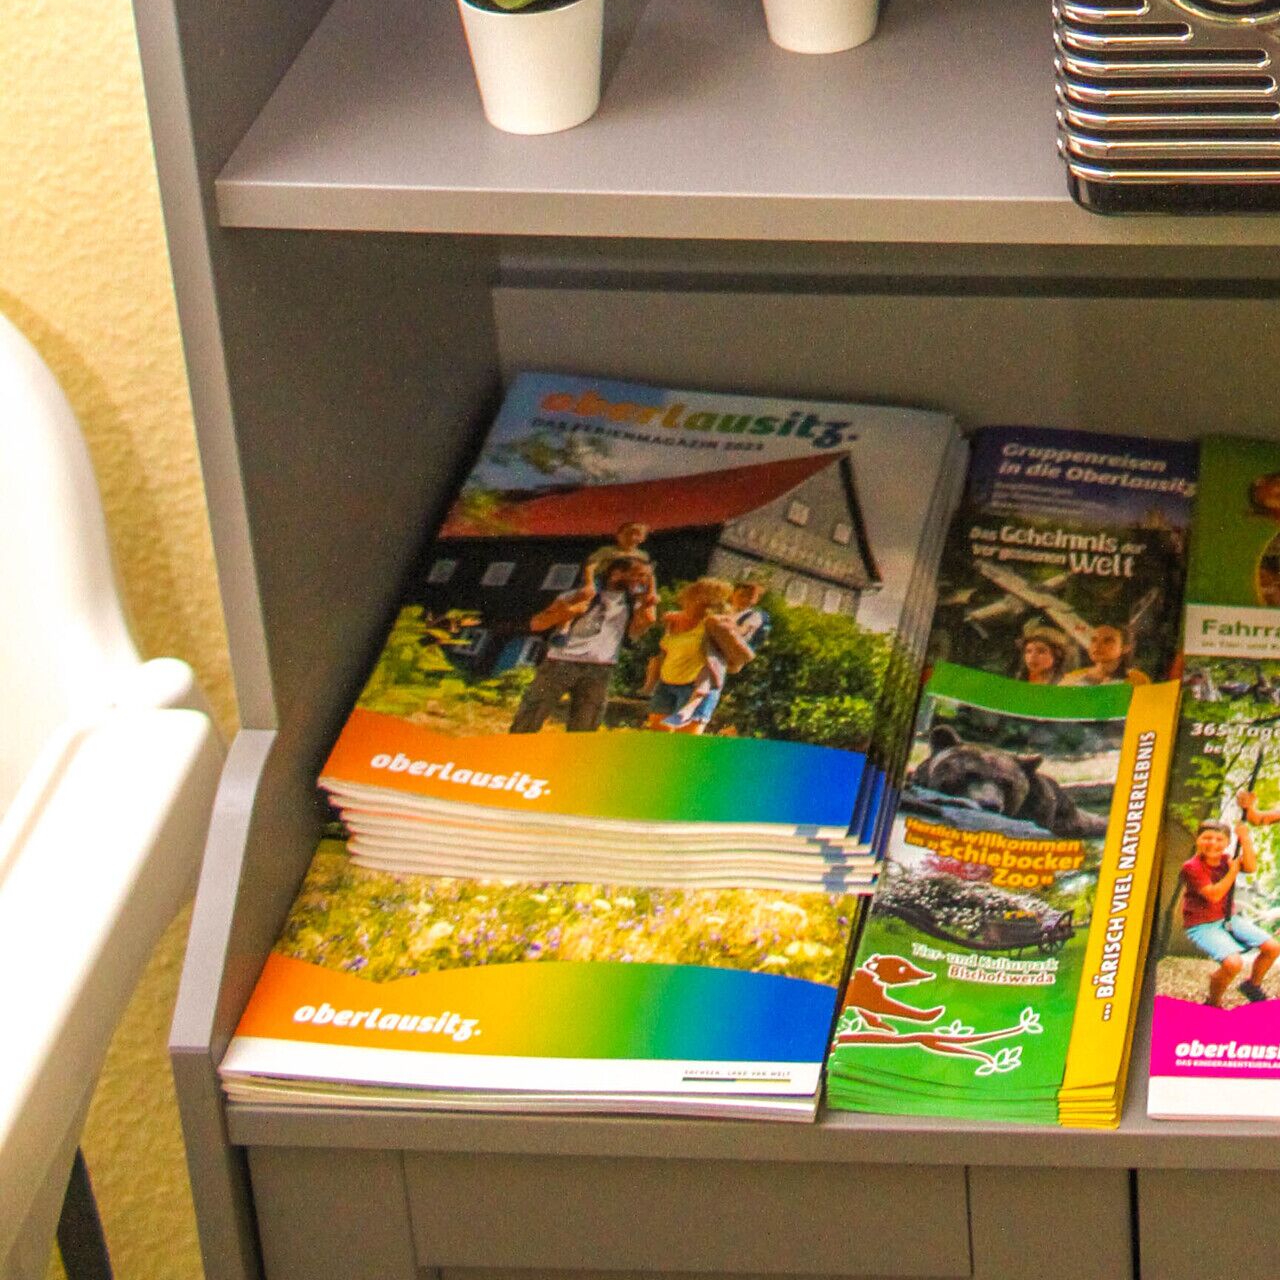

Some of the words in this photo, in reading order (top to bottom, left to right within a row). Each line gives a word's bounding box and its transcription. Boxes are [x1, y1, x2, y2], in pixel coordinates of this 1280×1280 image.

[1002, 443, 1167, 472] Gruppenreisen
[1070, 552, 1136, 577] Welt
[1190, 723, 1227, 737] 365
[1118, 731, 1156, 870] NATURERLEBNIS
[1111, 872, 1133, 914] VIEL
[1093, 917, 1126, 999] BÄRISCH
[949, 966, 1056, 984] Bischofswerda
